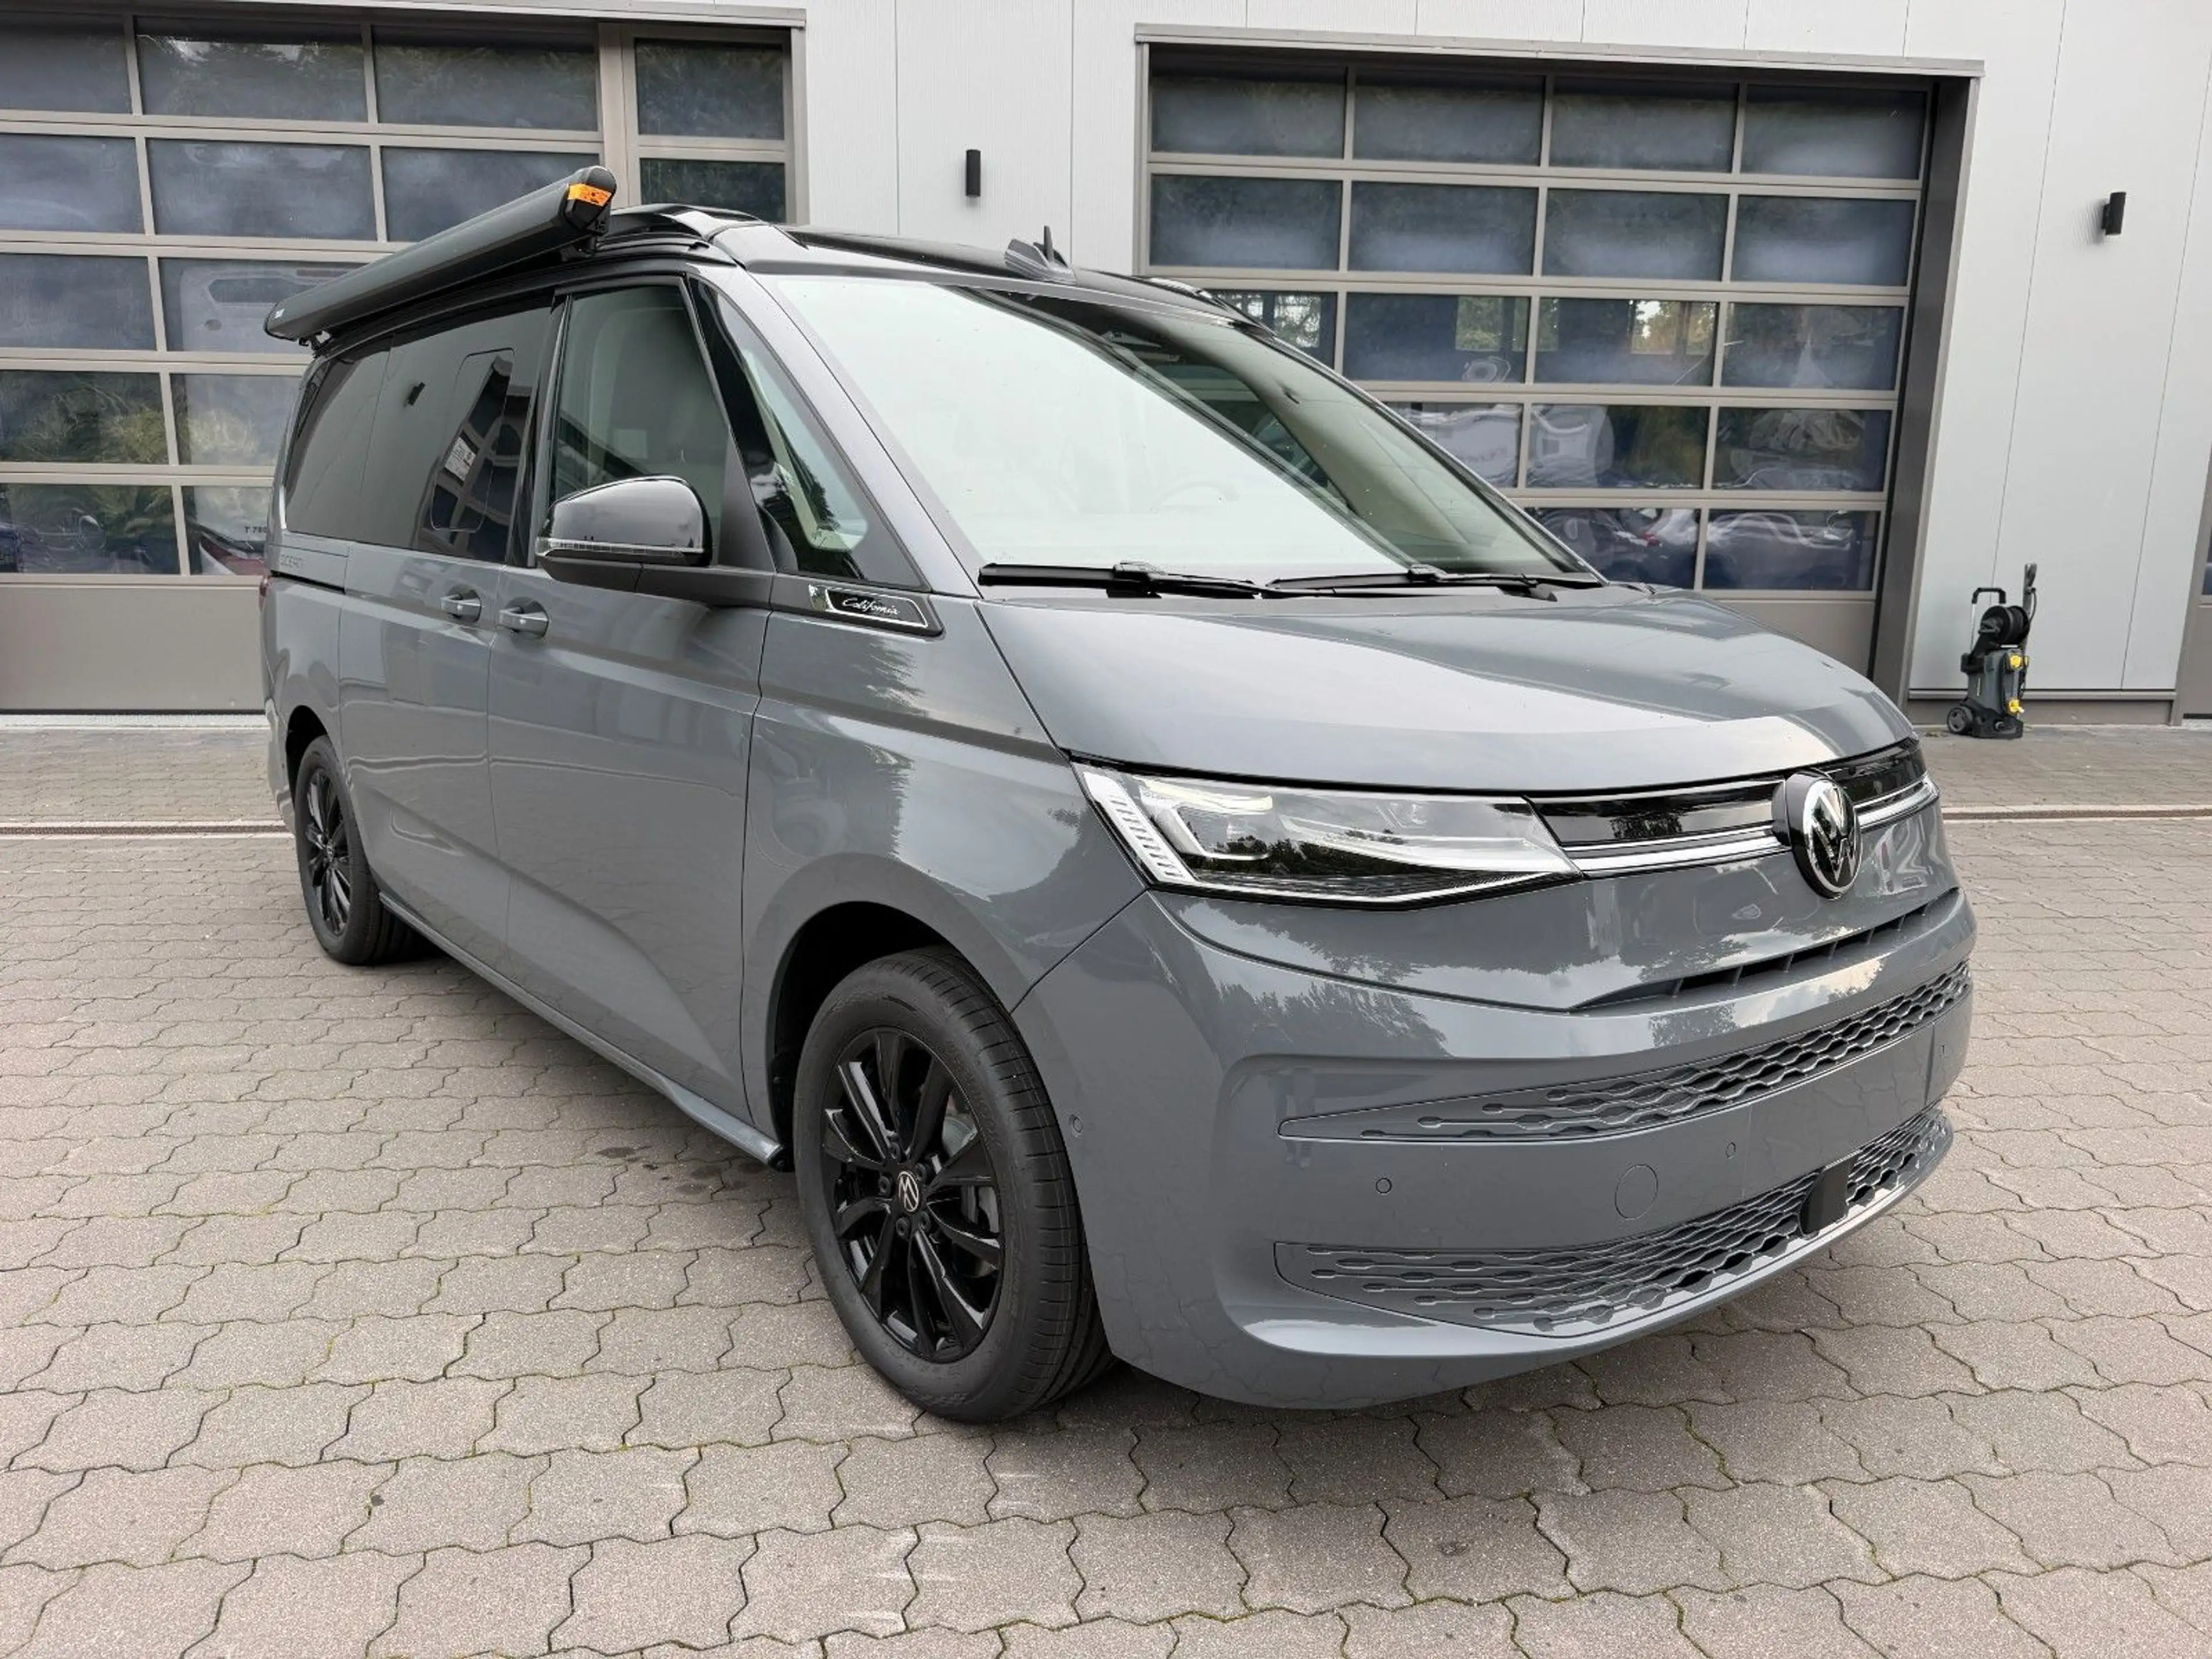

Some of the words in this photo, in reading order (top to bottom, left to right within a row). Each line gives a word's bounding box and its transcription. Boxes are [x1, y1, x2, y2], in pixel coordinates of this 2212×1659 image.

[841, 597, 900, 615] California
[1804, 780, 1862, 893] VW
[898, 1171, 919, 1212] VW
